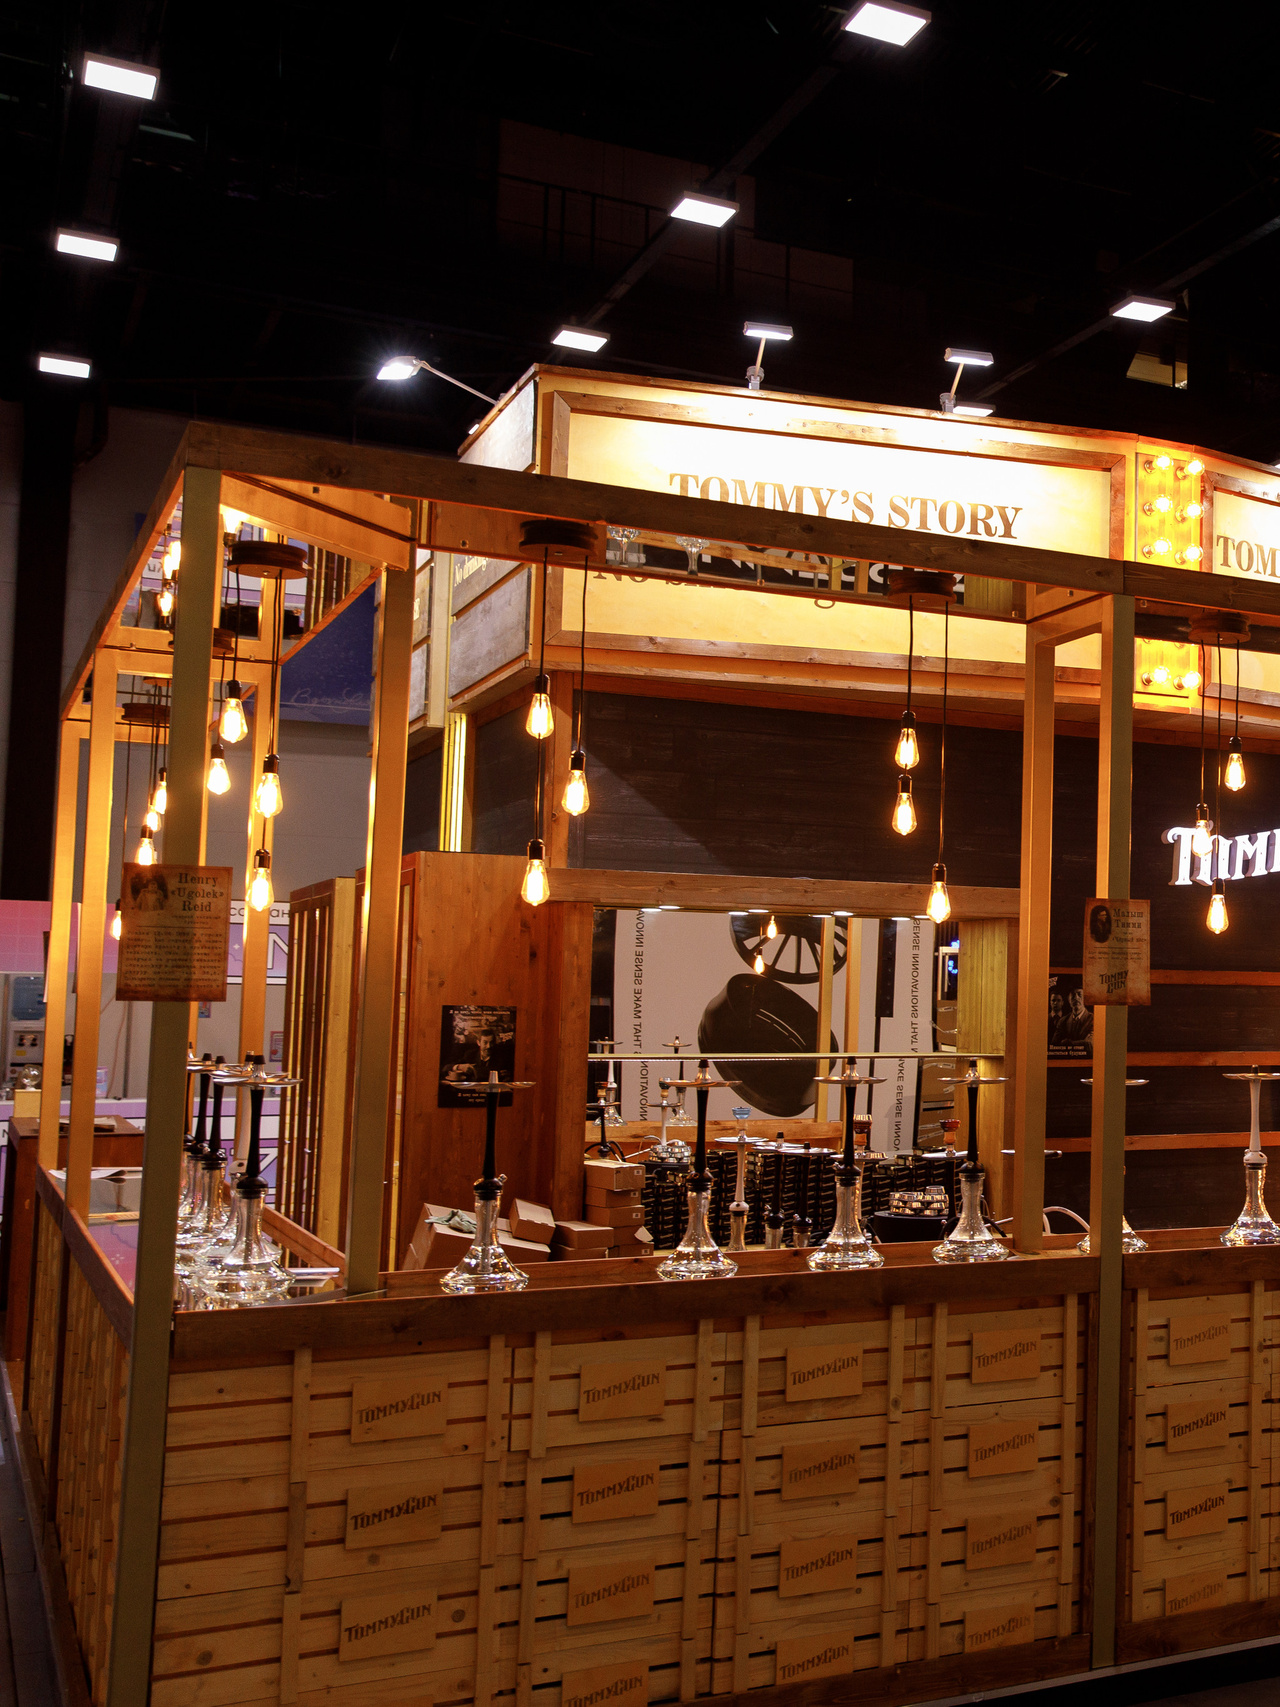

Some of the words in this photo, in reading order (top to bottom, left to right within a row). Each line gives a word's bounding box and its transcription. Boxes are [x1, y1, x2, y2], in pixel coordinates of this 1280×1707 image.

[888, 495, 1023, 539] STORY
[178, 872, 218, 887] Henry
[182, 900, 212, 912] Reid
